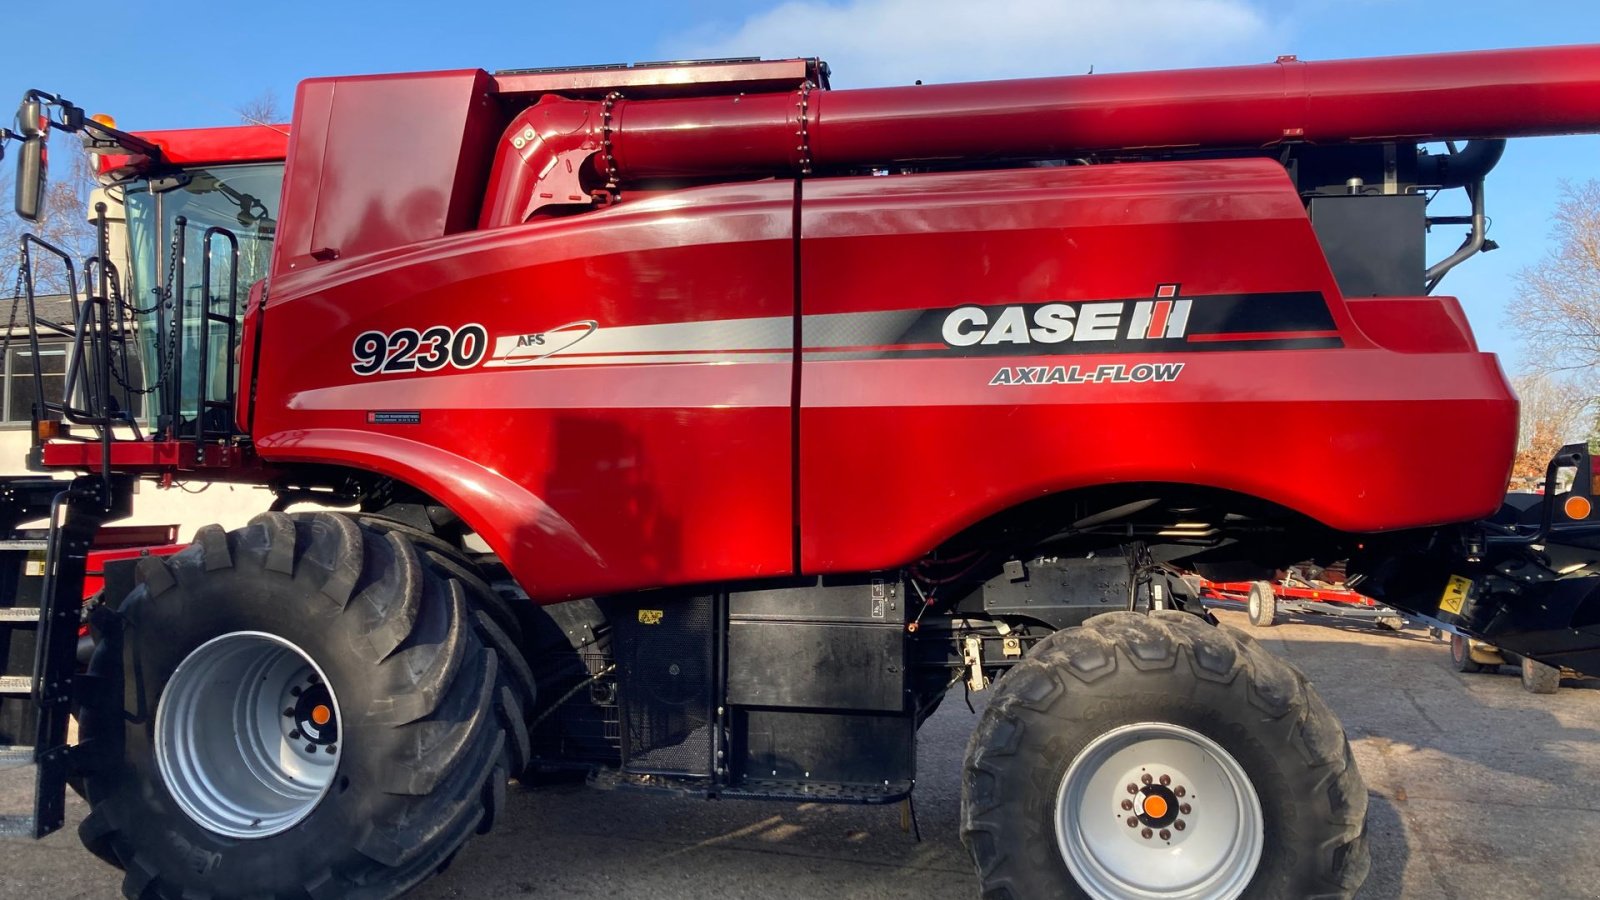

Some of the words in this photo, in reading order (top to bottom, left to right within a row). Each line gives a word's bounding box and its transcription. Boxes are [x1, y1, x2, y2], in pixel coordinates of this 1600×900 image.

[942, 302, 1124, 346] CASE
[352, 323, 488, 376] 9230
[516, 334, 546, 348] AFS
[988, 363, 1185, 385] AXIAL-FLOW
